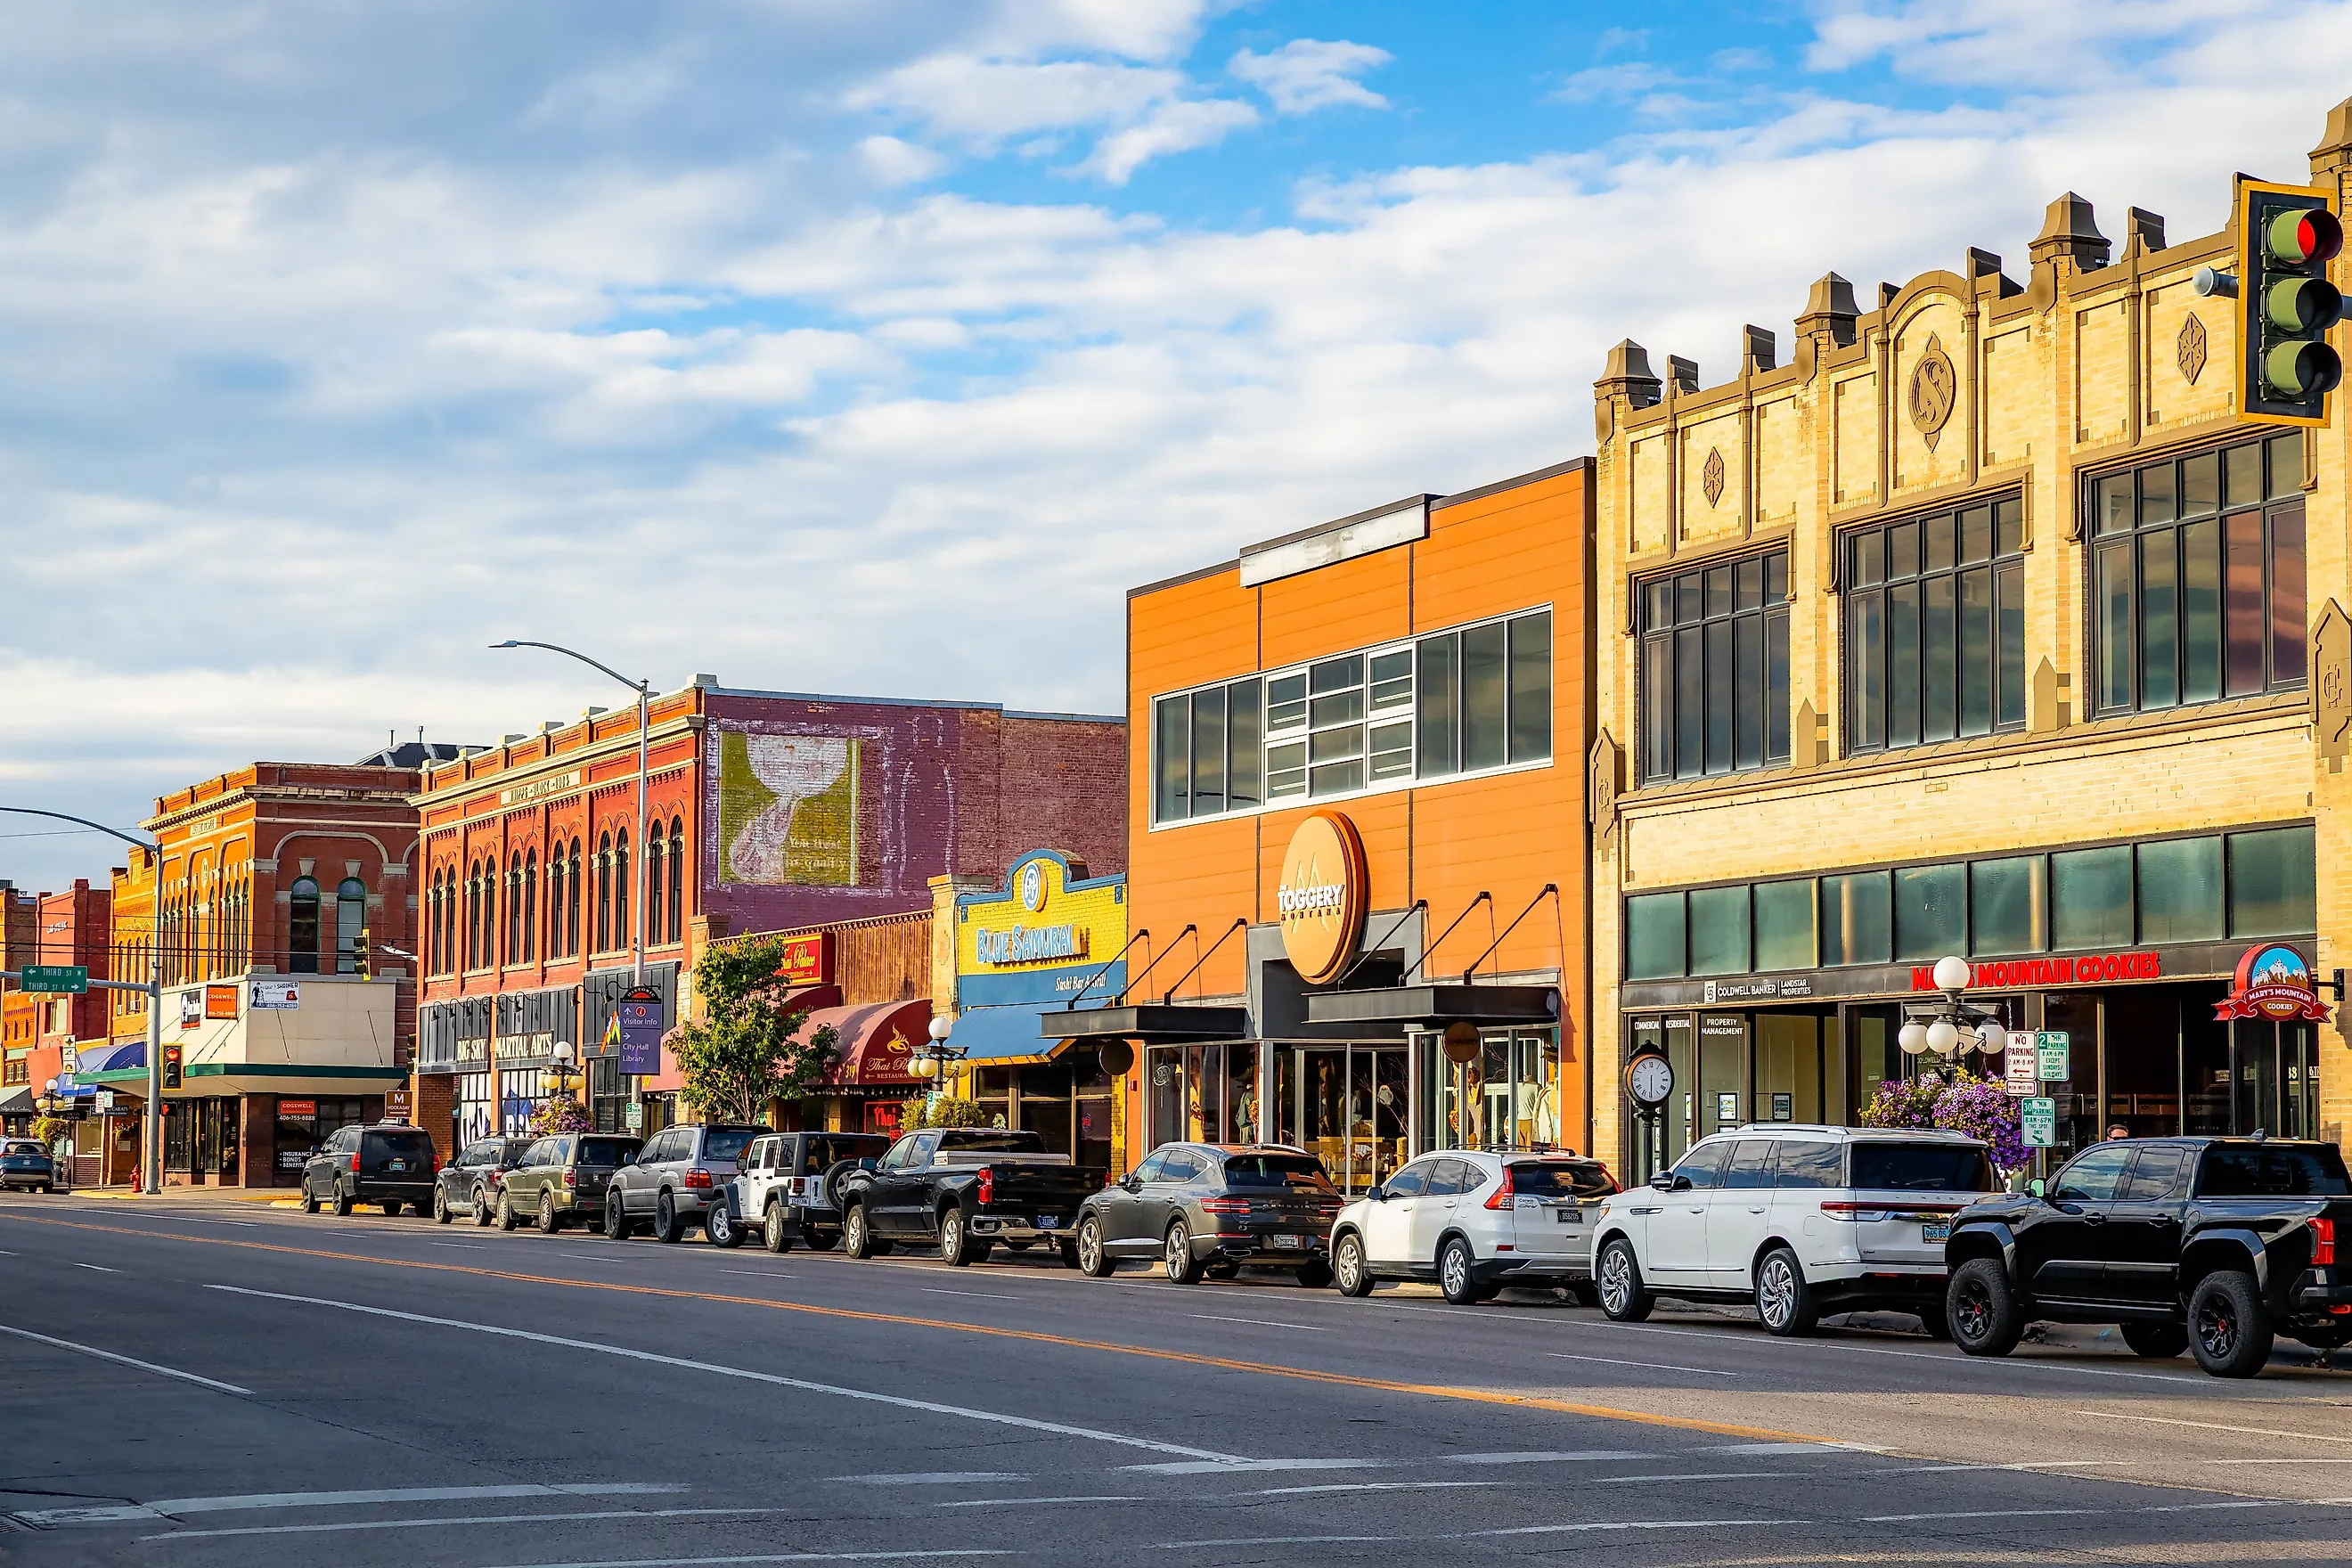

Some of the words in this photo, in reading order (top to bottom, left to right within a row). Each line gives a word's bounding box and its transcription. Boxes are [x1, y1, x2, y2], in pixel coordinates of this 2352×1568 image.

[1277, 884, 1343, 911] TOGGERY
[1280, 908, 1341, 921] MONTANA
[43, 968, 61, 976] THIRD
[1977, 958, 2074, 988] MOUNTAIN
[2075, 952, 2160, 983] COOKIES
[29, 982, 48, 991] THIRD
[1055, 976, 1073, 992] Sushi
[1073, 976, 1084, 990] Bar
[1091, 972, 1107, 989] Grill
[1781, 979, 1808, 988] LANDSTAR
[627, 987, 656, 997] HISTORIC
[1717, 985, 1751, 997] COLDWELL
[1752, 984, 1776, 995] BANKER
[1781, 986, 1812, 997] PROPERTIES
[2248, 988, 2274, 1001] MARY'S
[2274, 988, 2312, 1002] MOUNTAIN
[2266, 1002, 2293, 1011] COOKIES
[623, 1017, 643, 1025] Visitor
[644, 1017, 657, 1025] Info
[1634, 1020, 1660, 1031] COMMERCIAL
[1665, 1018, 1691, 1029] RESIDENTIAL
[1706, 1018, 1738, 1026] PROPERTY
[1701, 1027, 1744, 1035] MANAGEMENT
[2014, 1035, 2027, 1045] NO
[2038, 1034, 2046, 1048] 2
[457, 1039, 470, 1062] BIG
[470, 1038, 486, 1061] SKY
[494, 1034, 529, 1058] MARTIAL
[530, 1033, 552, 1057] ARTS
[622, 1042, 636, 1052] City
[636, 1042, 649, 1051] Hall
[2007, 1047, 2034, 1057] PARKING
[622, 1055, 645, 1064] Library
[866, 1057, 891, 1072] Thai
[845, 1065, 856, 1080] 319
[394, 1093, 404, 1104] M
[2023, 1102, 2032, 1112] 30
[874, 1106, 896, 1127] Thai
[1925, 1229, 1938, 1238] 965
